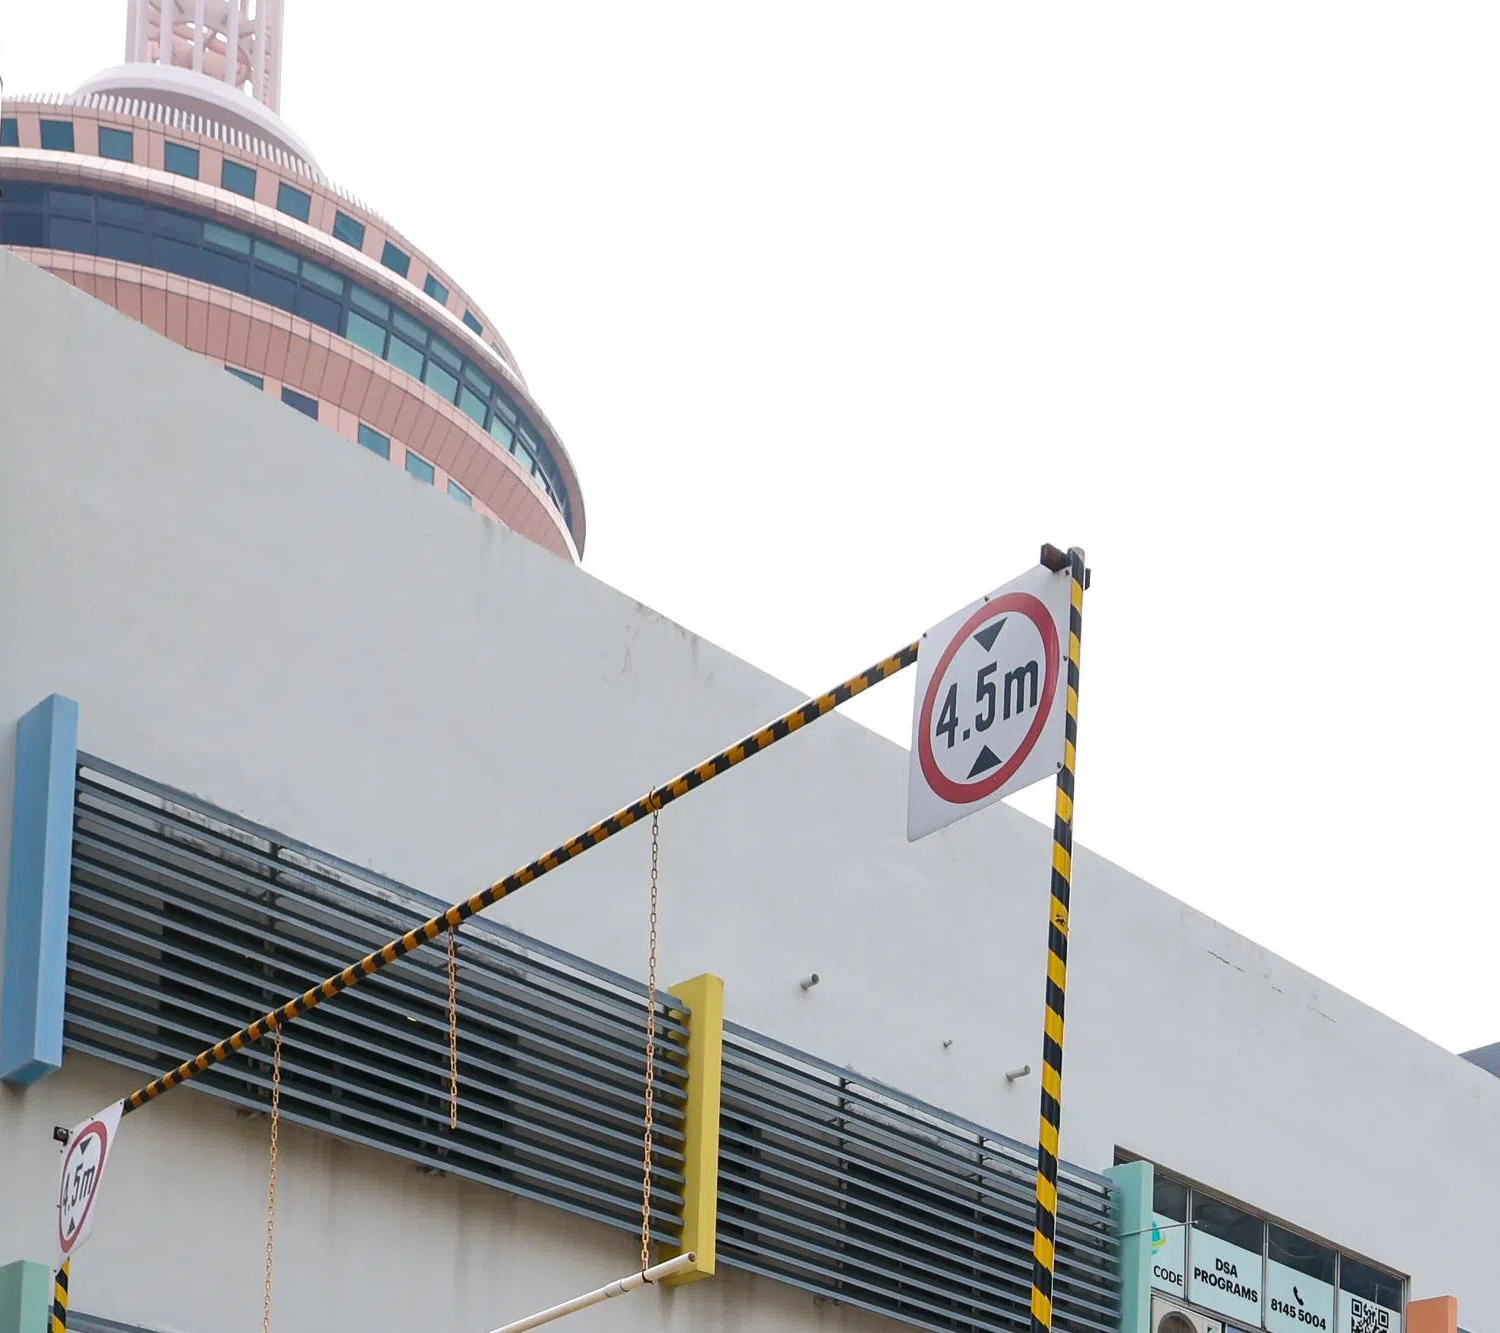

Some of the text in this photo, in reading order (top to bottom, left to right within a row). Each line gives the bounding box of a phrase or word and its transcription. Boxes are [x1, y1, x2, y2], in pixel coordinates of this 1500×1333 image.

[935, 658, 1039, 749] 4.5m
[61, 1162, 96, 1216] 4.5m
[1153, 1265, 1183, 1287] CODE
[1194, 1266, 1259, 1303] PROGRAMS
[1215, 1257, 1238, 1279] DSA
[1270, 1298, 1327, 1331] 8145 5004
